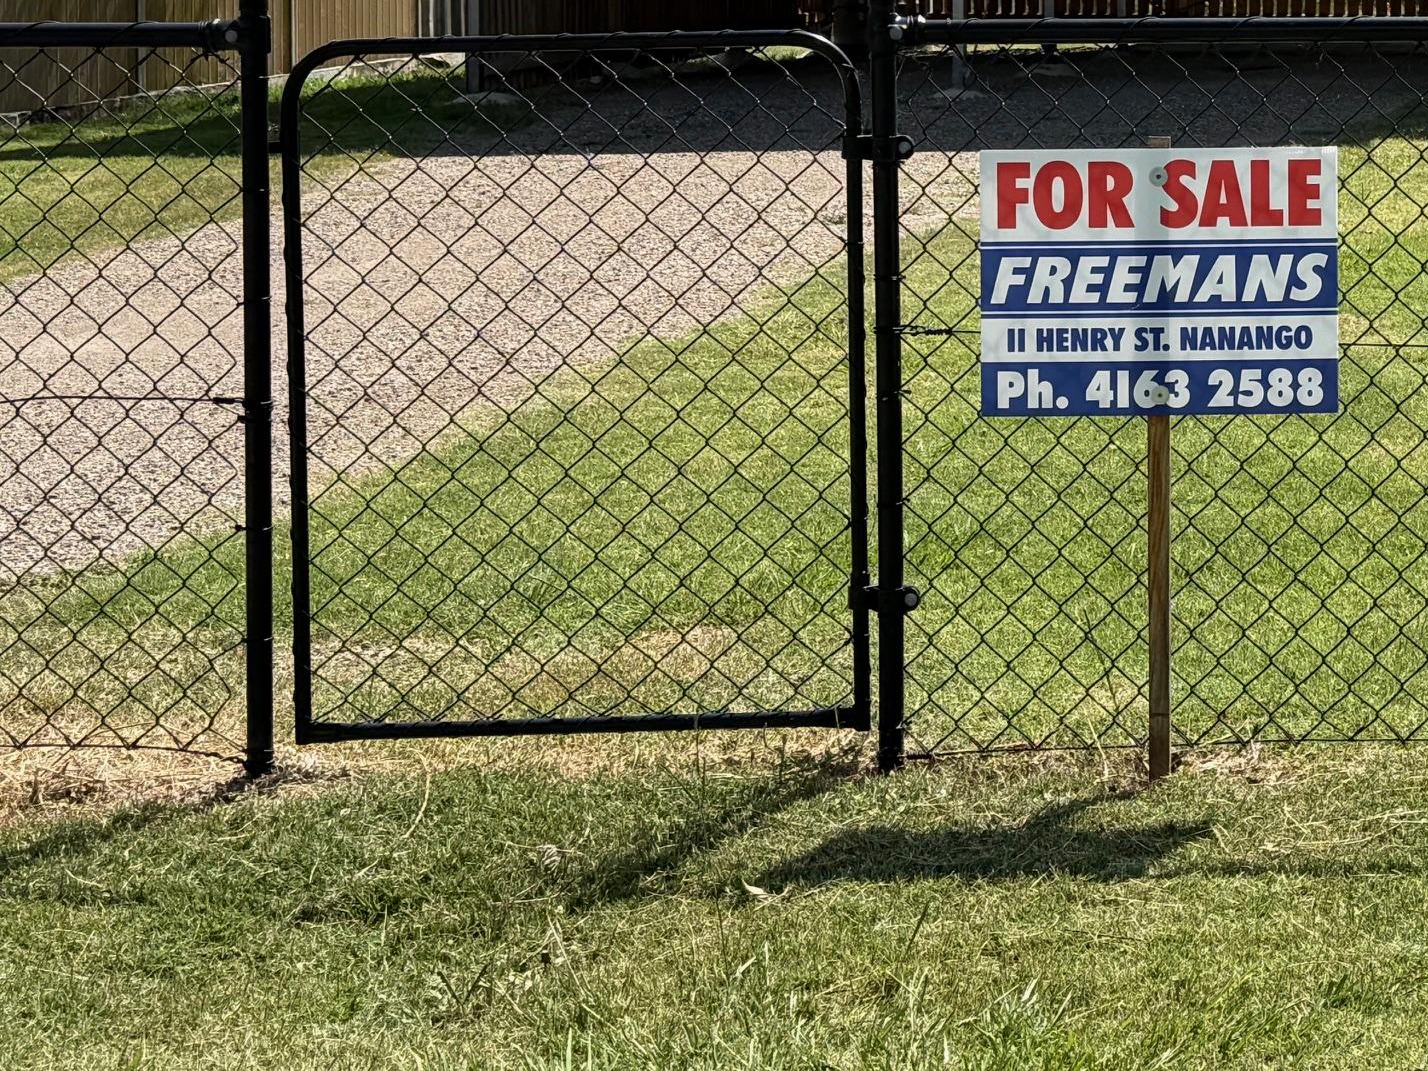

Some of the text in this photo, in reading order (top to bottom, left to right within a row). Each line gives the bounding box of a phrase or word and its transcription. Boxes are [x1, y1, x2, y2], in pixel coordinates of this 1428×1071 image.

[996, 159, 1322, 229] FOR SALE
[990, 252, 1329, 304] FREEMANS
[1036, 327, 1126, 352] HENRY
[1134, 327, 1170, 351] ST.
[1180, 325, 1313, 350] NANANGO
[997, 368, 1324, 409] Ph. 4163 2588
